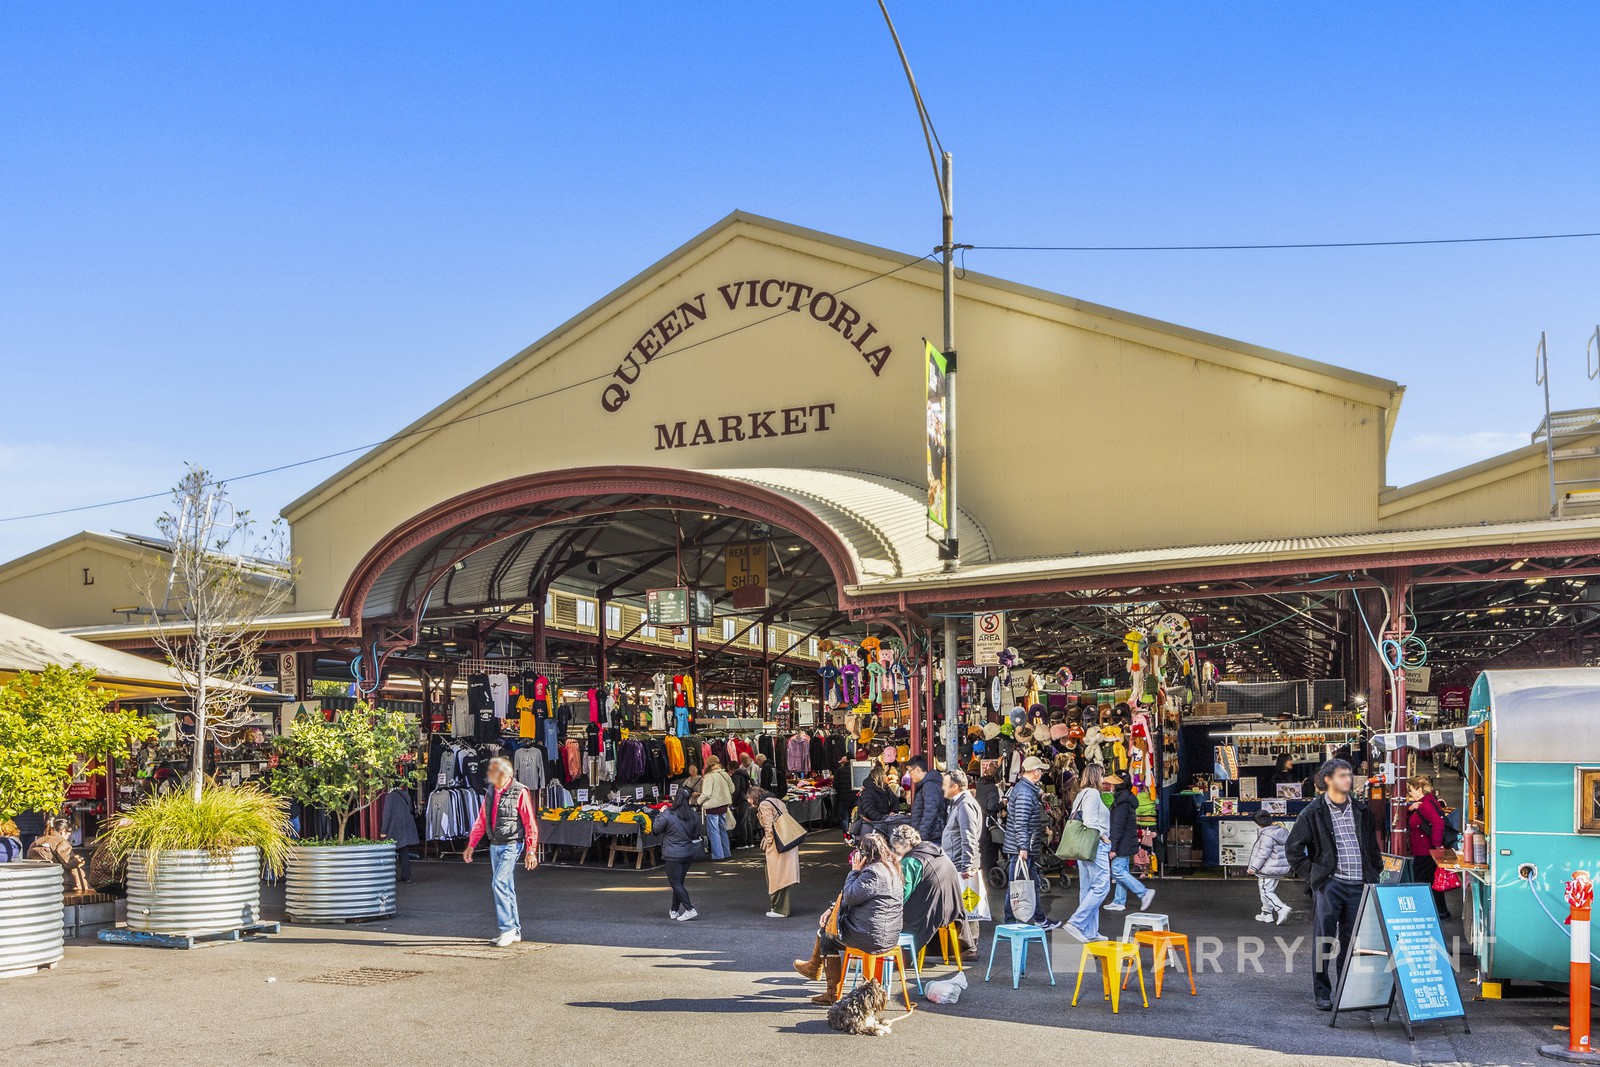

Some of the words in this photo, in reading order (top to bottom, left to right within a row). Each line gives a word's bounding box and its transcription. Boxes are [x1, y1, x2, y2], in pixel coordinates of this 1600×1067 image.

[601, 293, 708, 413] QUEEN
[718, 279, 893, 377] VICTORIA
[654, 403, 835, 451] MARKET
[83, 568, 95, 586] L
[1397, 896, 1416, 911] MENU
